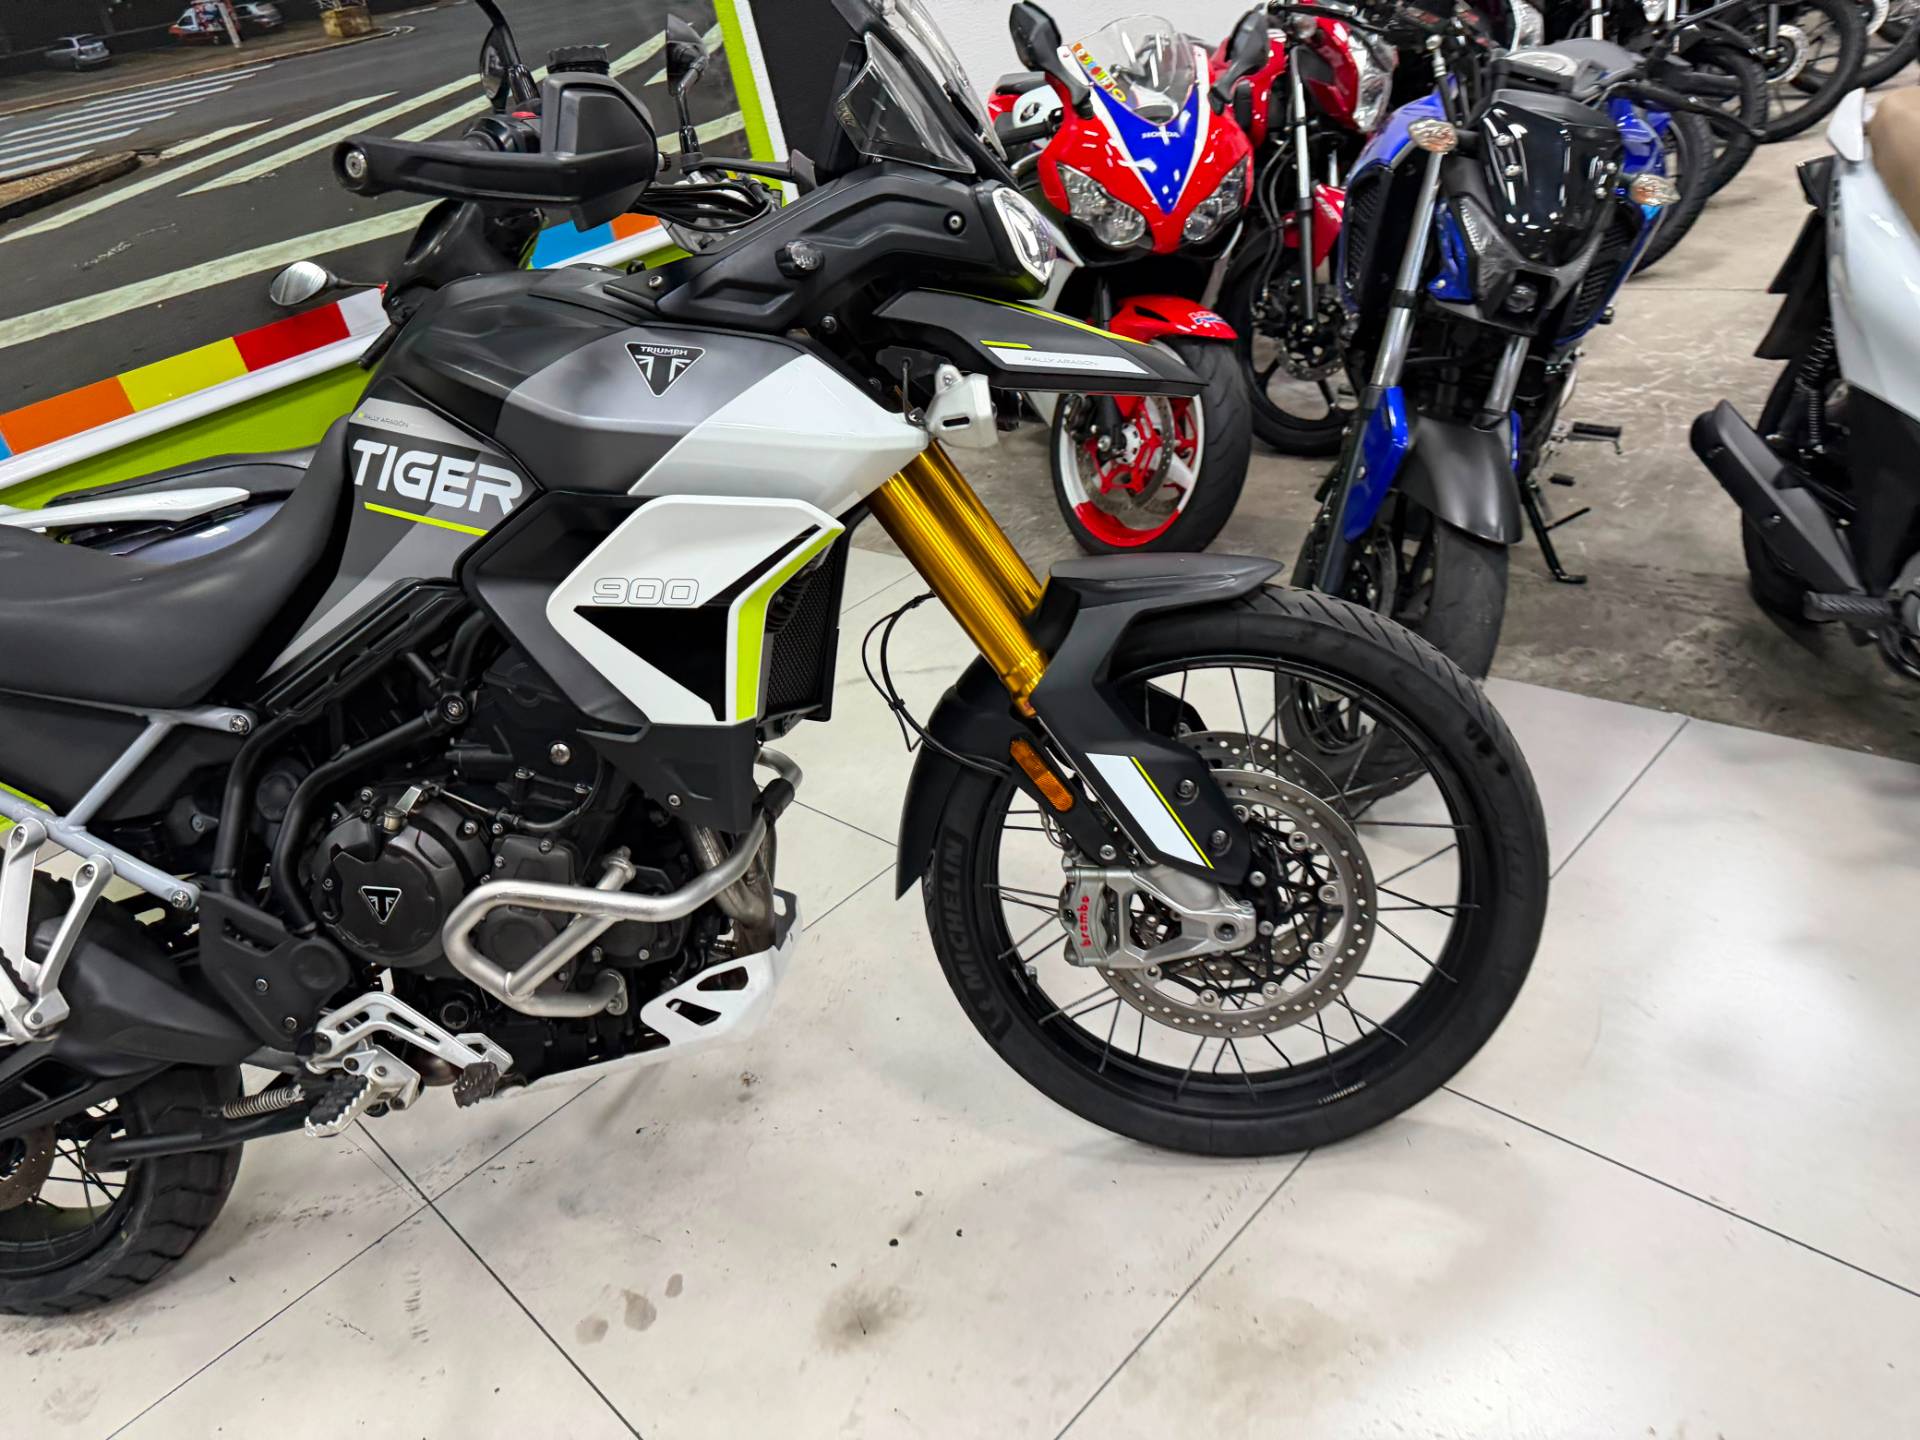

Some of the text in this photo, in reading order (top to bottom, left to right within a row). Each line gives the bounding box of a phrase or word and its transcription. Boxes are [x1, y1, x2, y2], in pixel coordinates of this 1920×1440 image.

[640, 346, 688, 356] TRIUMPH
[353, 439, 523, 515] TIGER
[592, 577, 699, 606] 900
[942, 835, 985, 990] MICHELIN
[1076, 895, 1093, 948] brembo
